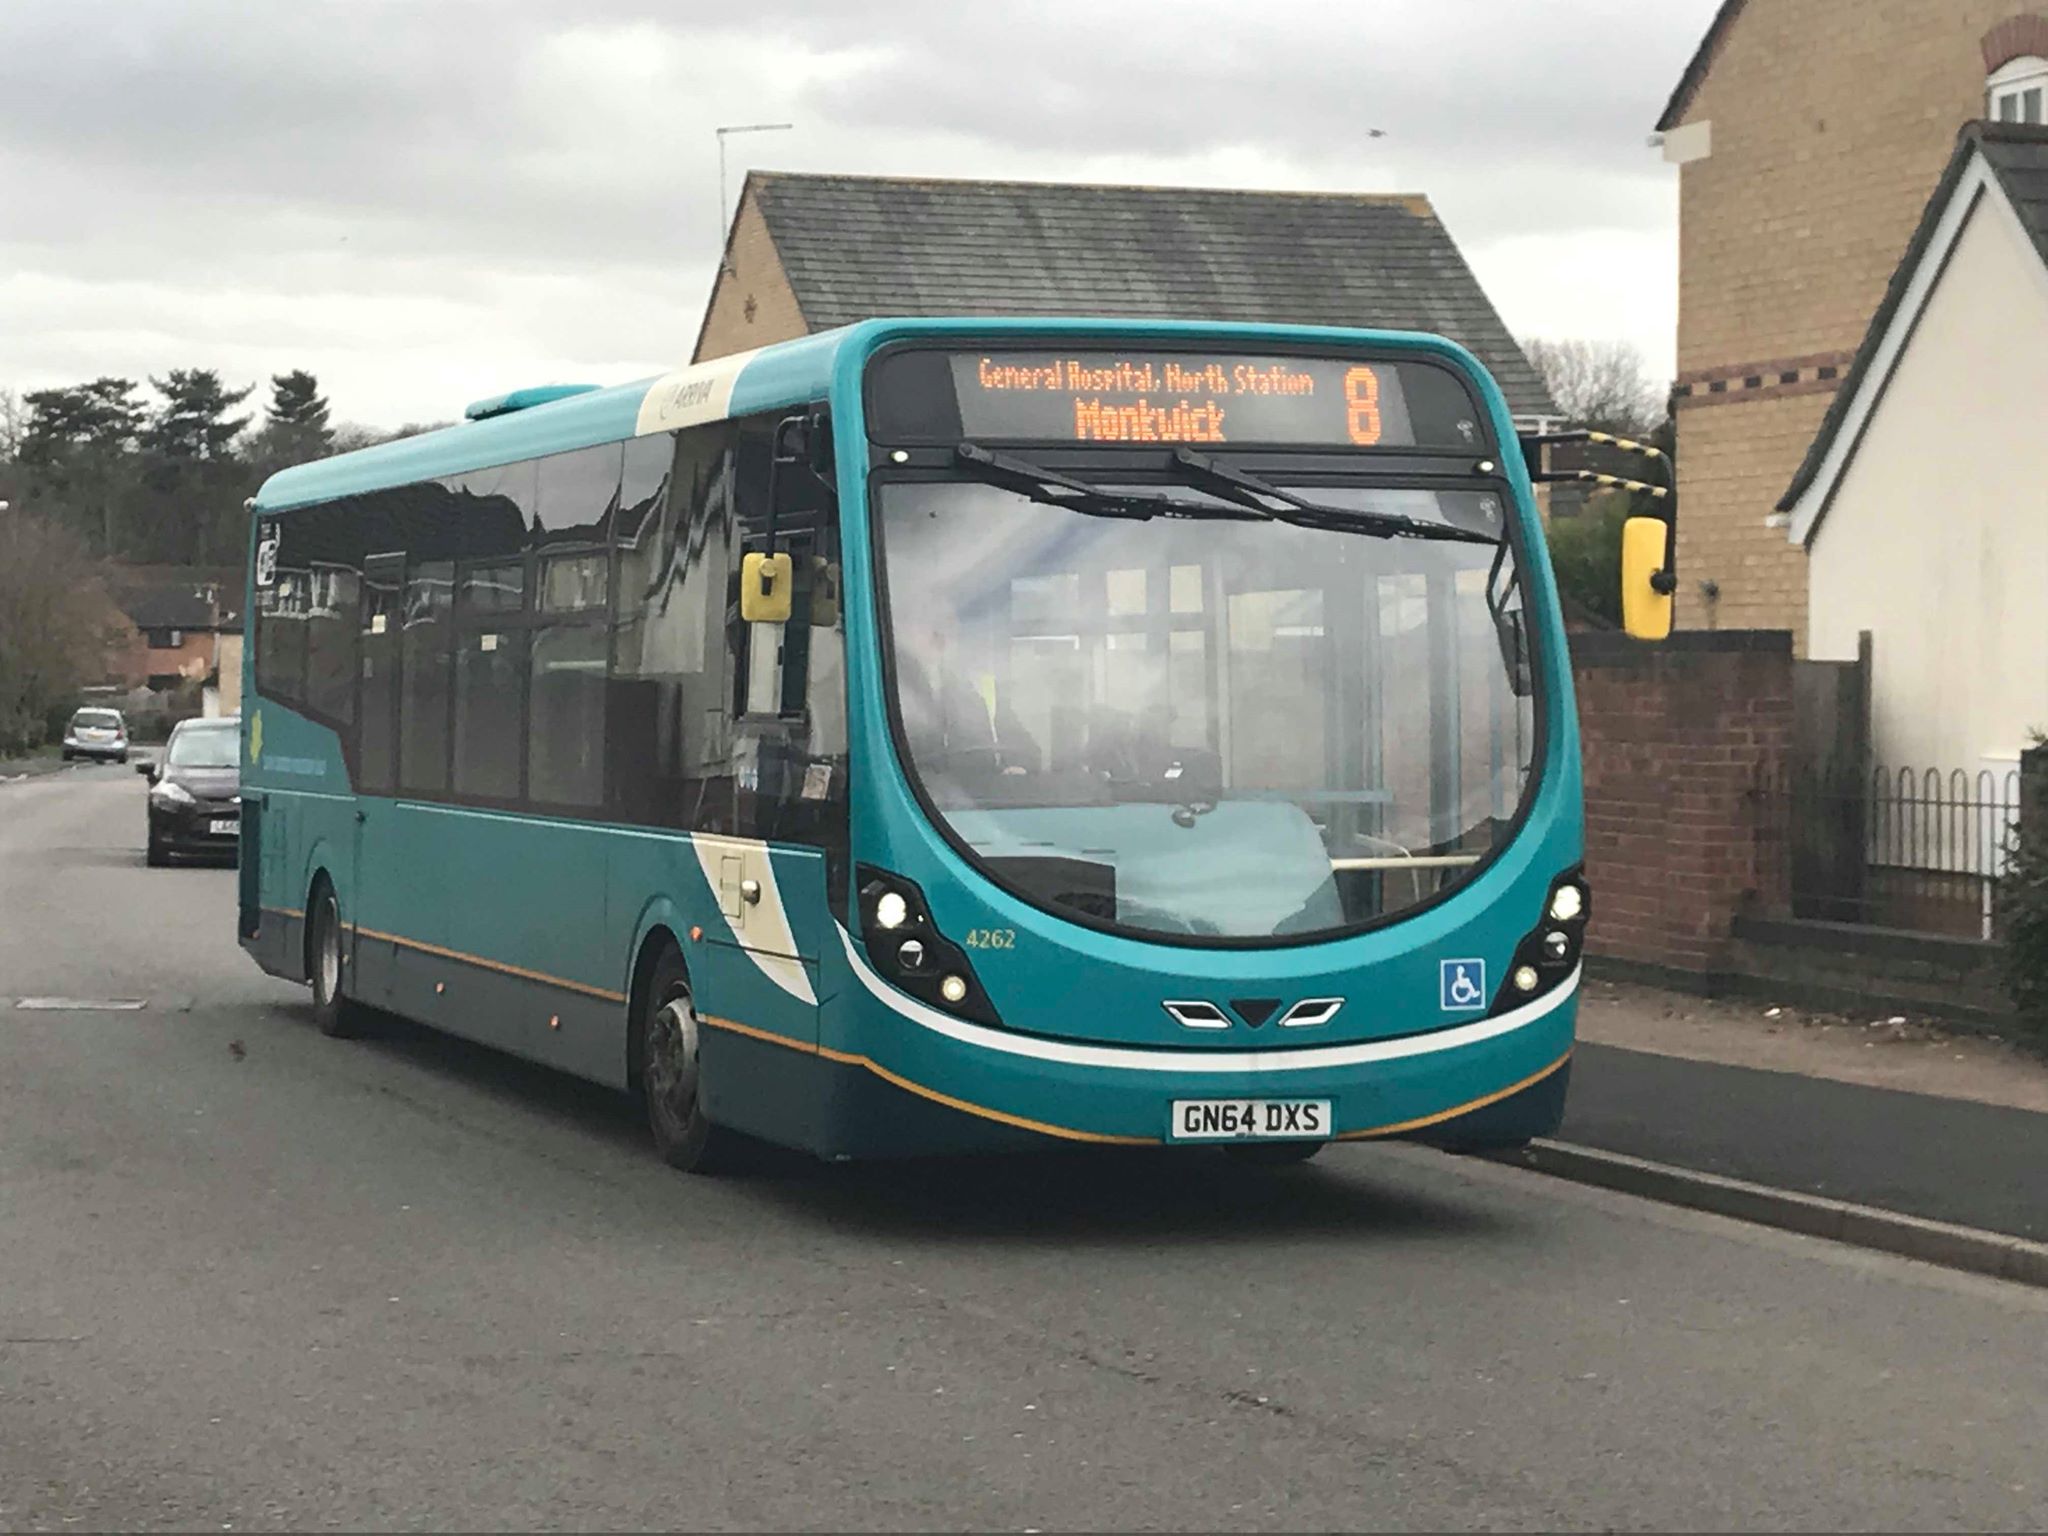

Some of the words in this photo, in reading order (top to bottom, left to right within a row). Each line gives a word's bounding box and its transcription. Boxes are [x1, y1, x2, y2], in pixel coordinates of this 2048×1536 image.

[979, 357, 1062, 390] General
[1164, 362, 1228, 394] North
[1233, 364, 1314, 396] Station
[1076, 397, 1226, 442] Monkwick
[1345, 367, 1381, 445] 8
[966, 928, 1016, 949] 4262
[1184, 1104, 1256, 1132] GN64
[1265, 1103, 1319, 1131] DXS
